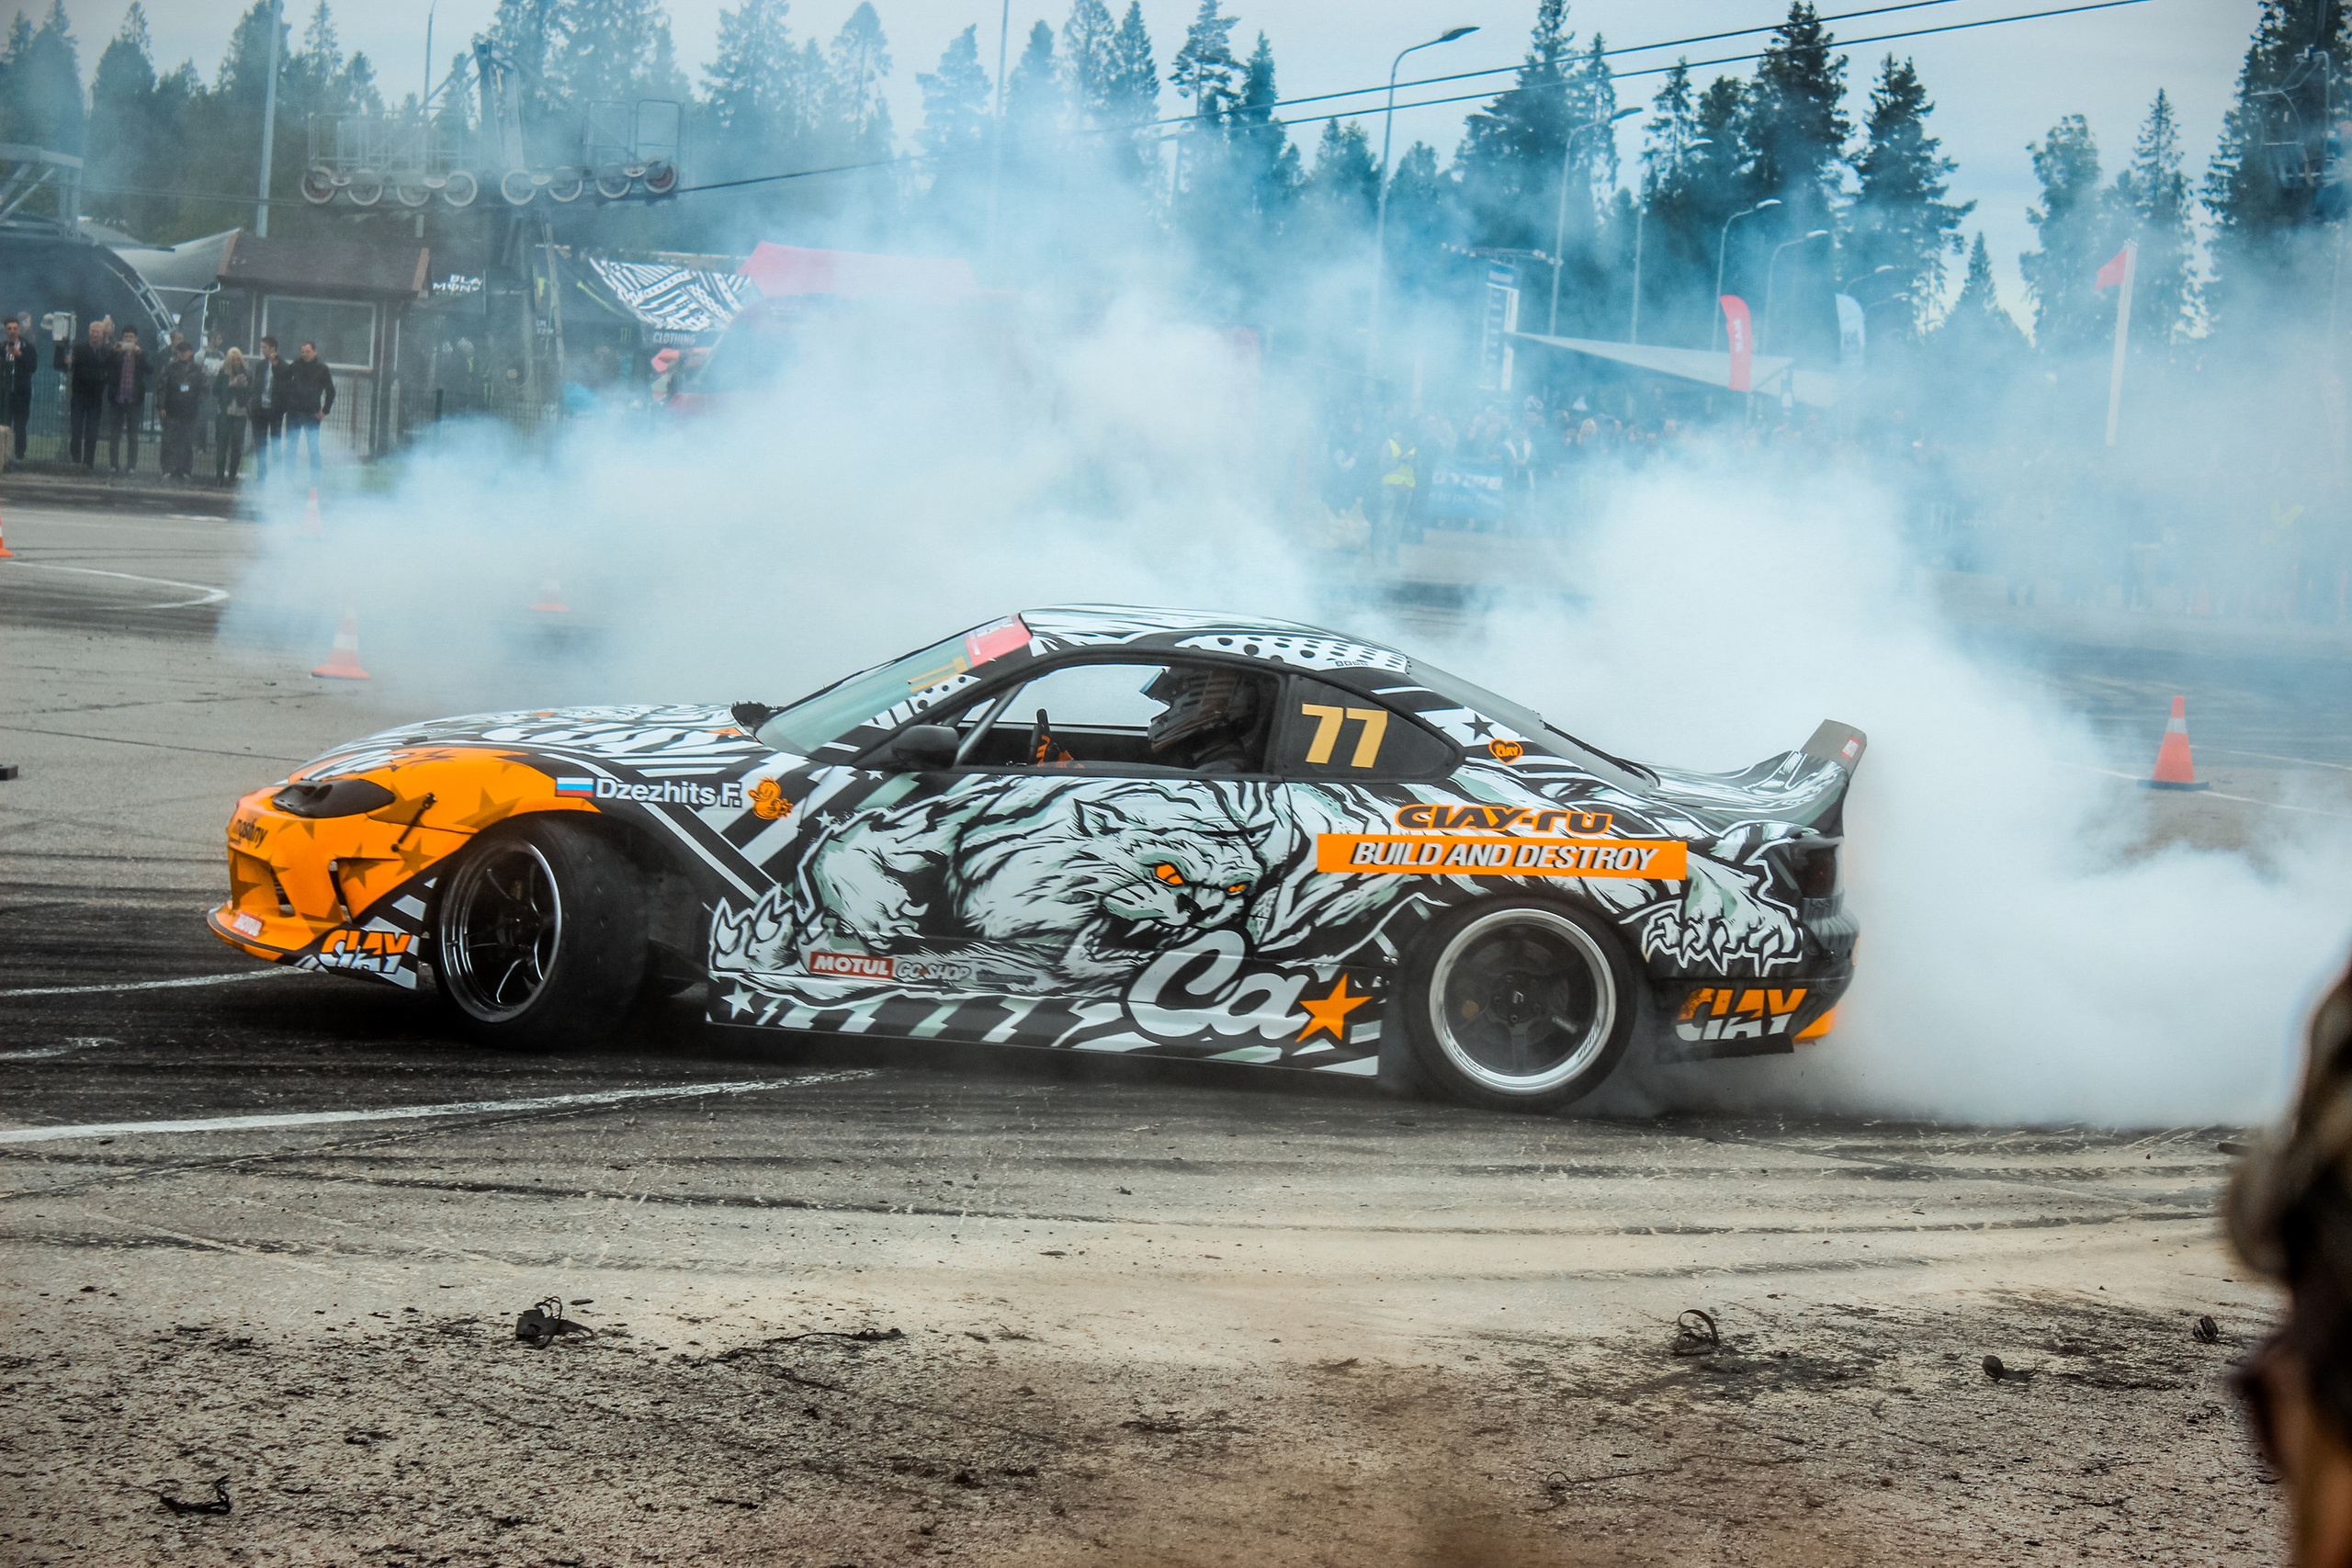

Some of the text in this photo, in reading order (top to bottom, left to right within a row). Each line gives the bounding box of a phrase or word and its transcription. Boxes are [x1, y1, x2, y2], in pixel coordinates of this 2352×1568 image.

[653, 332, 696, 346] CLOTHING
[1301, 704, 1388, 769] 77
[595, 778, 742, 807] Dzezhits F.
[1352, 841, 1659, 871] BUILD AND DESTROY
[813, 954, 889, 976] MOTUL
[1676, 987, 1808, 1042] CLAY
